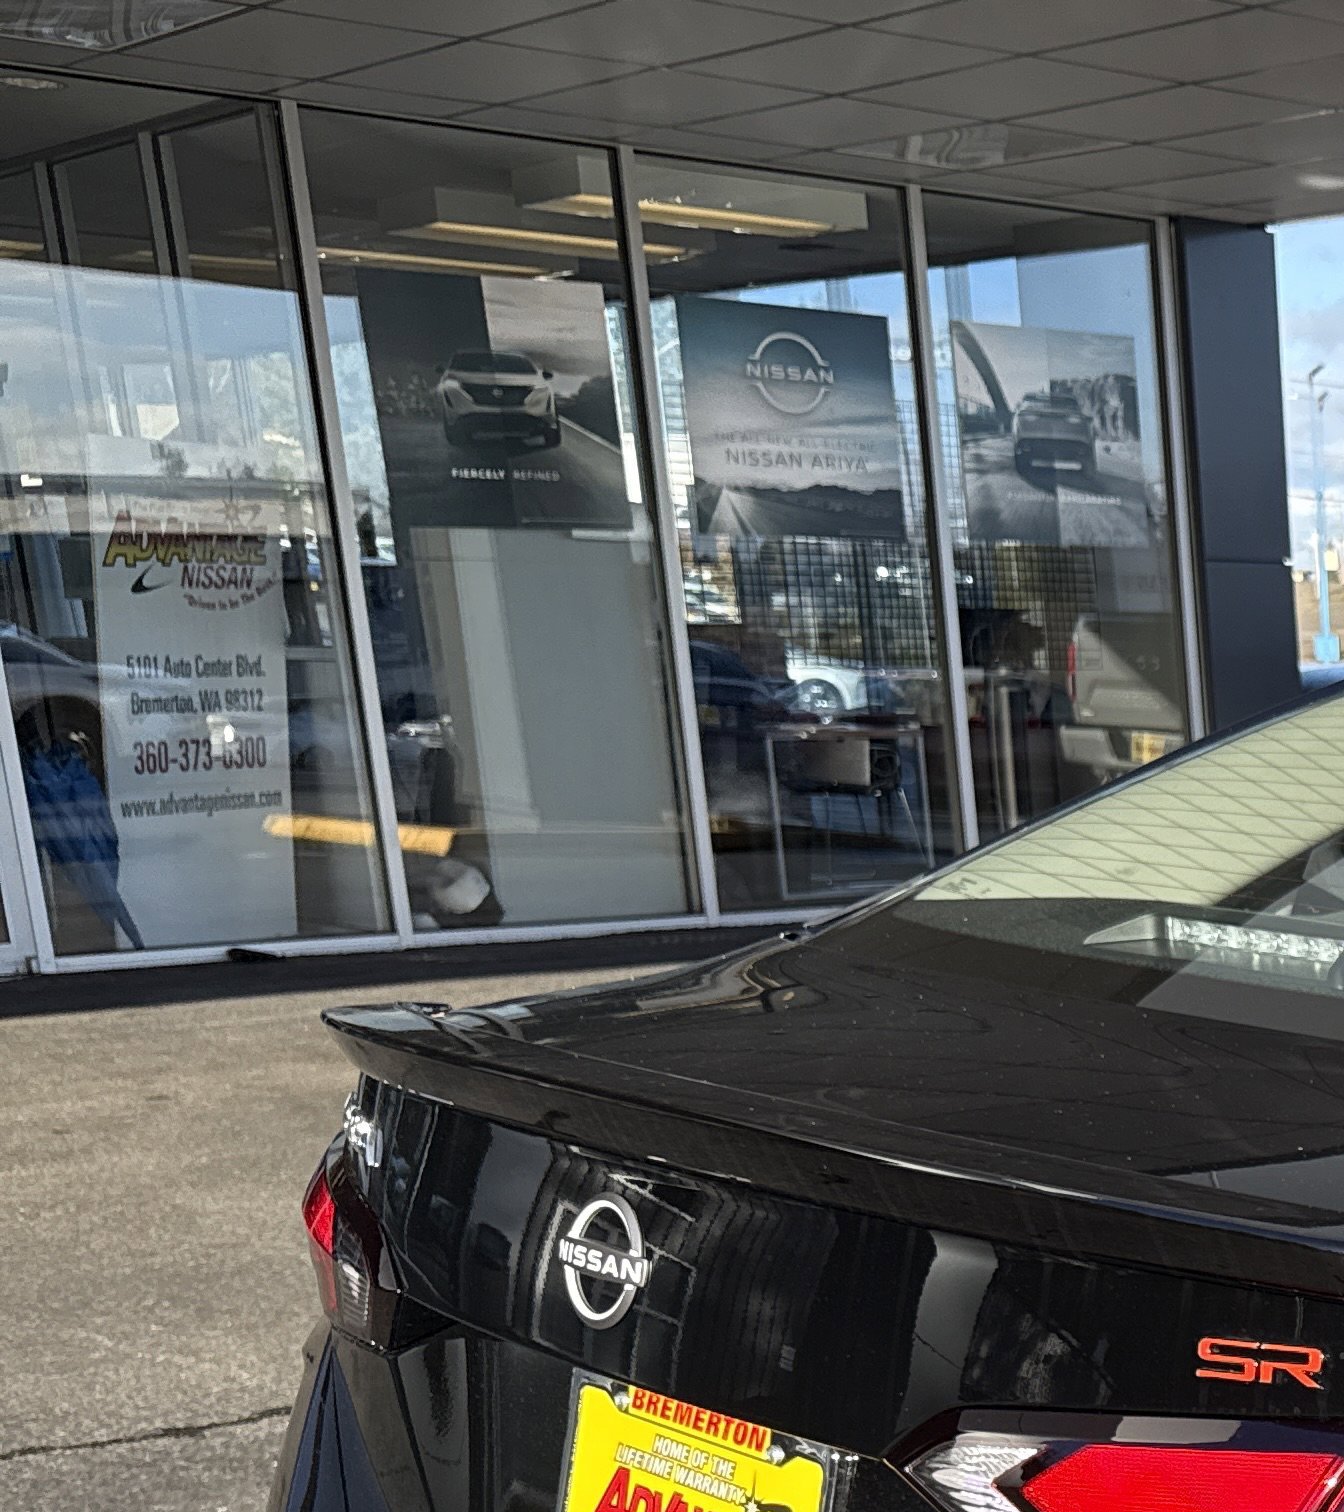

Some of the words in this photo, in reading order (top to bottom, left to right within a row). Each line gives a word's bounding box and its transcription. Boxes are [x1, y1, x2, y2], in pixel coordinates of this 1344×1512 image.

[746, 362, 834, 384] NISSAN
[725, 447, 802, 468] NISSAN
[810, 452, 869, 474] ARIYA
[102, 508, 267, 568] ADVANTAGE
[180, 563, 254, 590] NISSAN
[126, 653, 159, 680] 5101
[163, 653, 192, 679] Auto
[195, 653, 233, 678] Center
[235, 653, 266, 677] Blvd.
[130, 691, 198, 716] Bremerton,
[199, 688, 222, 713] WA
[120, 788, 283, 818] www.advantagenissan.com
[558, 1238, 644, 1285] NISSAN
[1195, 1337, 1325, 1390] SR
[631, 1387, 768, 1453] BREMERTON
[614, 1442, 675, 1482] LIFETIME
[673, 1462, 748, 1506] WARRANTY
[652, 1432, 692, 1464] HOME
[690, 1446, 711, 1471] OF
[710, 1453, 737, 1481] THE
